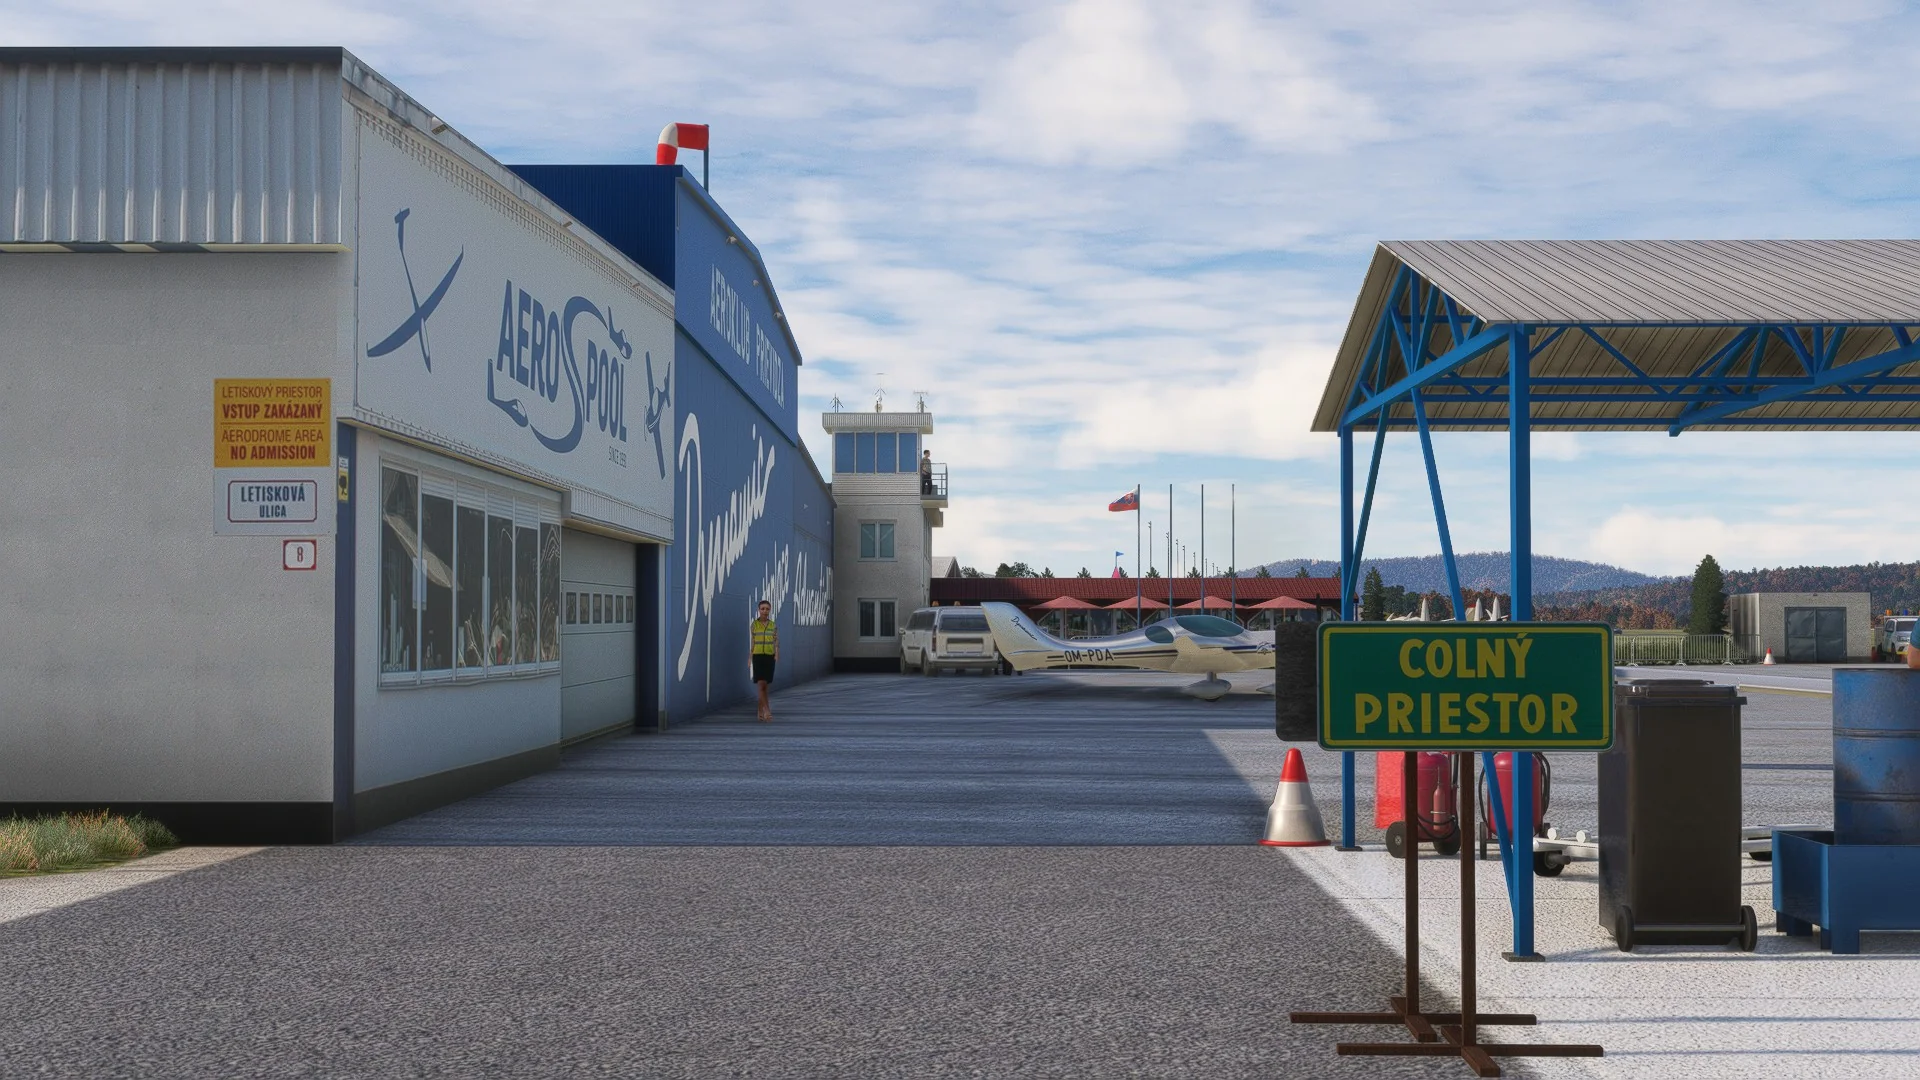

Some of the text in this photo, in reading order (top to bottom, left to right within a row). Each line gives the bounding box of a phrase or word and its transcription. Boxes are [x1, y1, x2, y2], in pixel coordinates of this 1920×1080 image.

[710, 264, 750, 365] AEROKLUB
[222, 384, 323, 398] LETISKOVÝ PRIESTOR
[223, 400, 323, 419] VSTUP ZAKÁZANÝ
[221, 429, 324, 443] AERODROME AREA
[230, 445, 316, 460] NO ADMISSION
[241, 483, 305, 502] LETISKOVÁ
[259, 505, 287, 518] ULICA
[296, 546, 304, 563] 8
[678, 412, 775, 702] Dynamic
[1064, 648, 1115, 663] OM-PDA
[1399, 632, 1533, 679] COLNÝ
[1355, 693, 1578, 734] PRIESTOR
